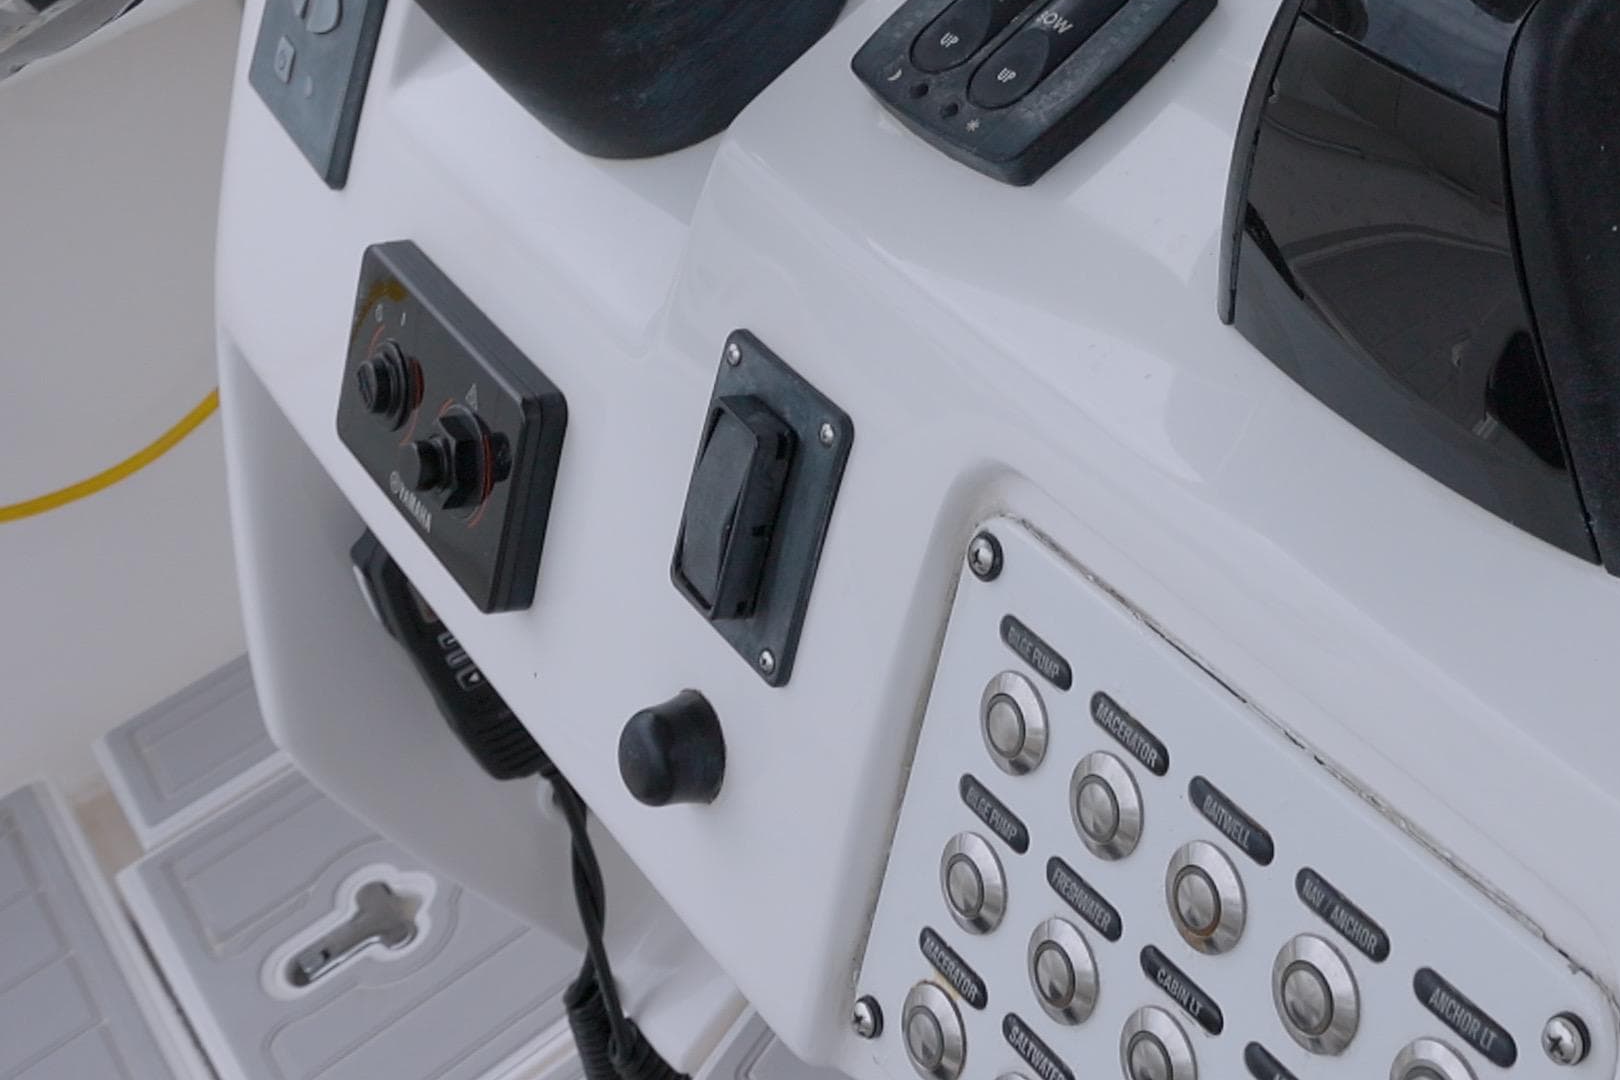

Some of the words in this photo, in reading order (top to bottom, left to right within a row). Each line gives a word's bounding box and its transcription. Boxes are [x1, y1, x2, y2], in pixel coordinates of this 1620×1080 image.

[939, 31, 960, 49] UP
[996, 67, 1017, 84] UP
[398, 486, 432, 534] YAMAHA
[1032, 646, 1060, 680] PUMP
[1096, 702, 1159, 768] MACERATOR
[989, 808, 1018, 841] PUMP
[1203, 793, 1252, 851] BAITWELL
[1051, 867, 1112, 932] FRESHWATER
[1331, 903, 1379, 956] ANCHOR
[923, 935, 979, 1003] MACERATOR
[1156, 968, 1190, 1003] CABIN
[1188, 996, 1203, 1018] LT
[1428, 986, 1481, 1039] ANCHOR
[1479, 1027, 1499, 1052] LT
